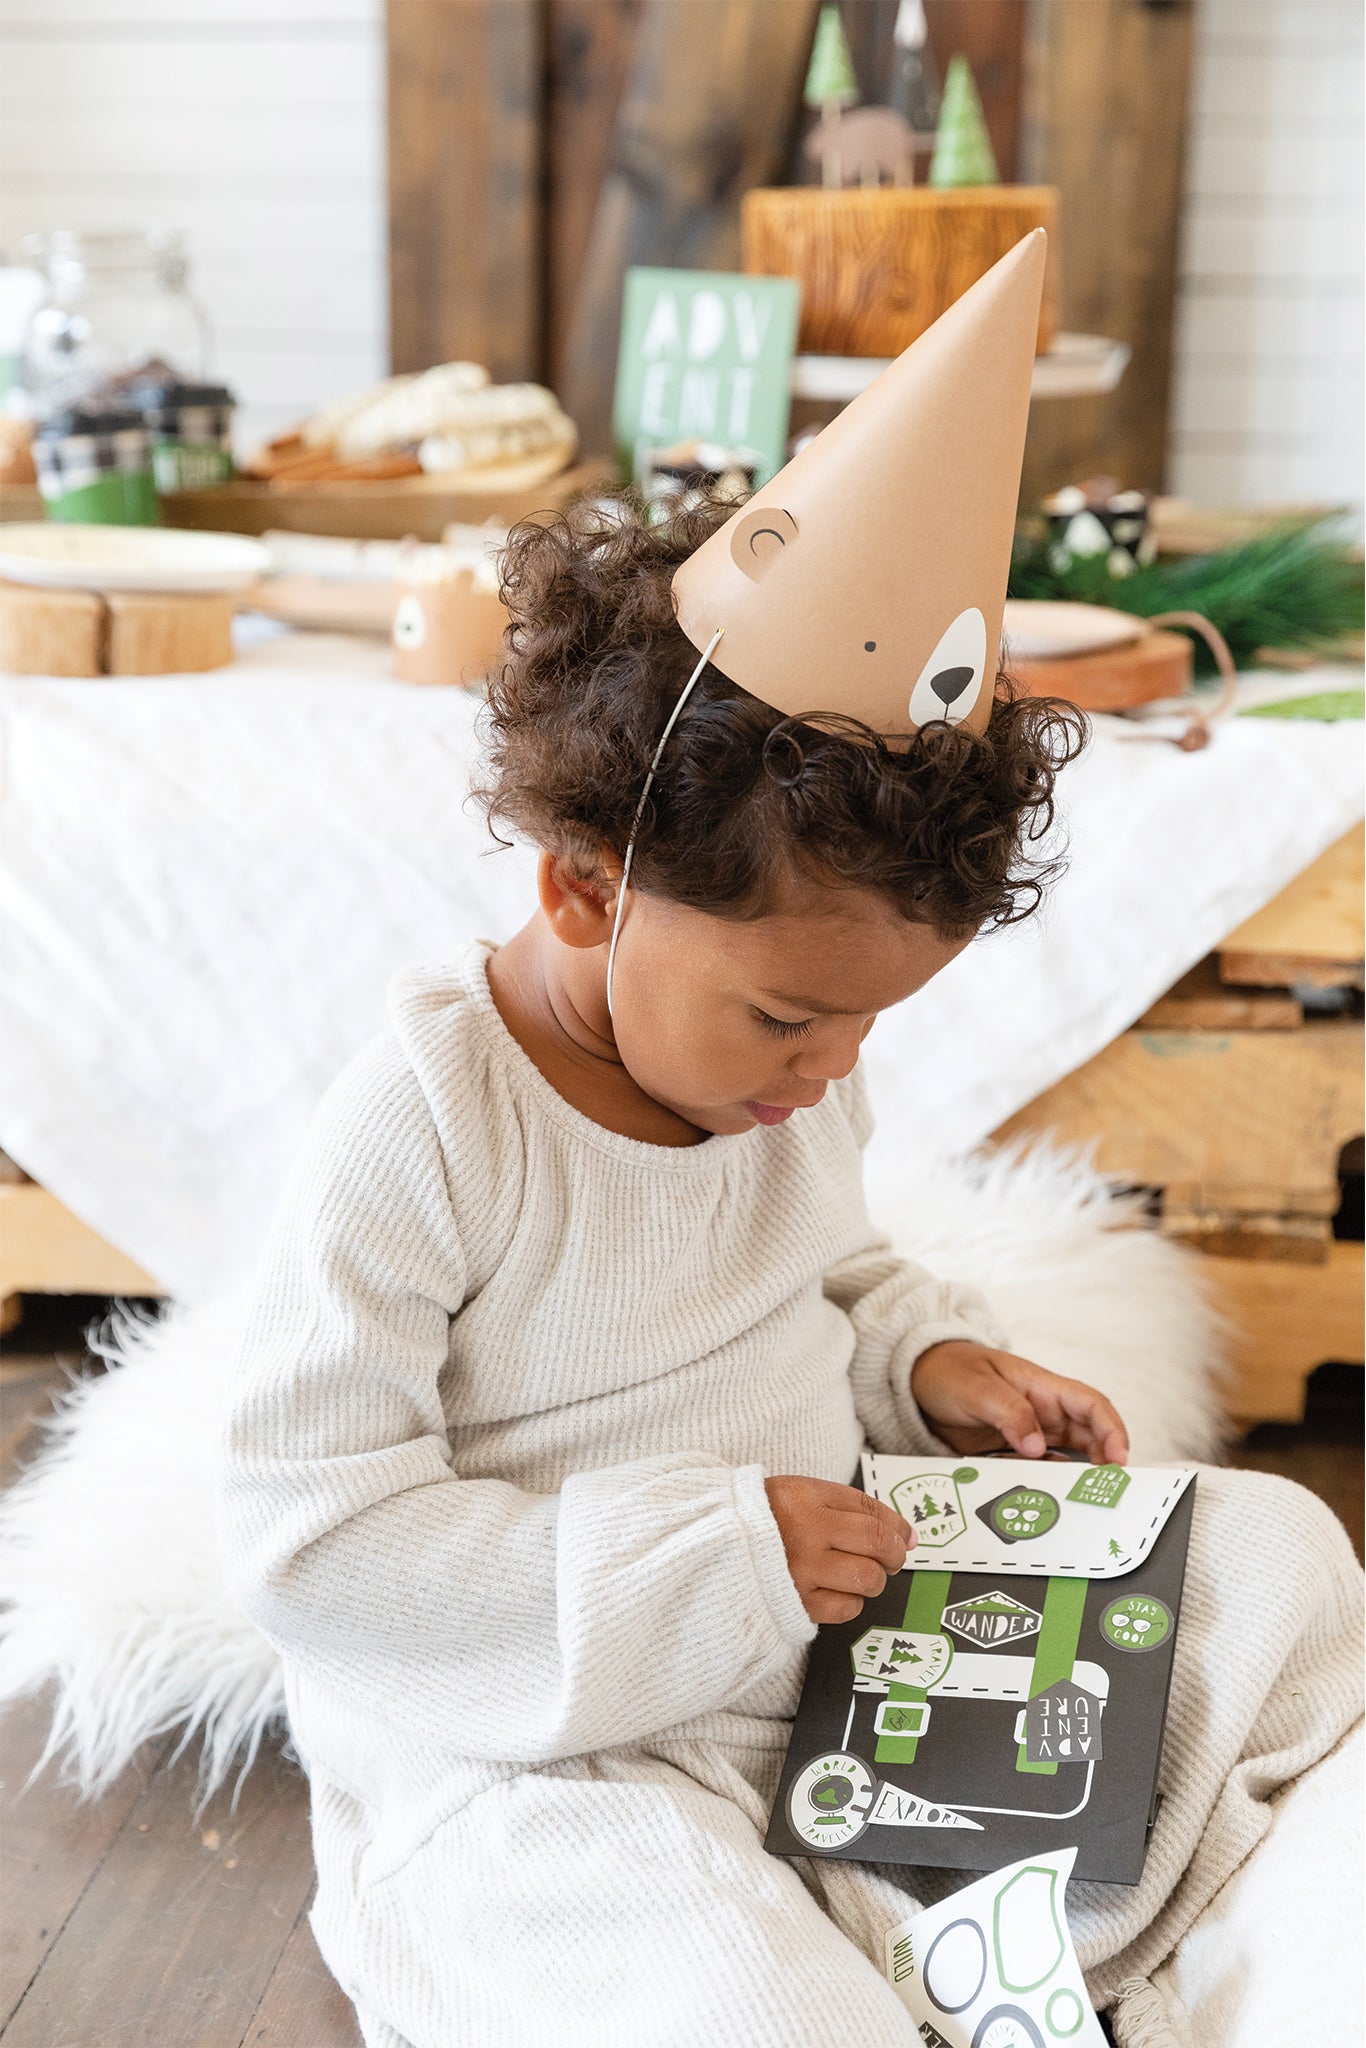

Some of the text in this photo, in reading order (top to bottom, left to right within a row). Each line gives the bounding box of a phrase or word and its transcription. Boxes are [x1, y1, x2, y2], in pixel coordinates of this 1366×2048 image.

[641, 290, 773, 362] ADV
[1084, 1477, 1120, 1491] WILD
[1015, 1494, 1045, 1506] STAY
[1078, 1493, 1110, 1504] BRAVE
[919, 1521, 957, 1540] MORE
[1005, 1521, 1037, 1533] COOL
[1127, 1600, 1159, 1616] STAY
[951, 1611, 1035, 1639] WANDER
[1113, 1629, 1145, 1645] COOL
[859, 1635, 883, 1669] MORE
[1038, 1696, 1090, 1717] URE
[1038, 1736, 1093, 1757] ADV
[810, 1760, 857, 1776] WORLD
[874, 1790, 960, 1826] EXPLORE
[893, 1933, 914, 1984] WILD
